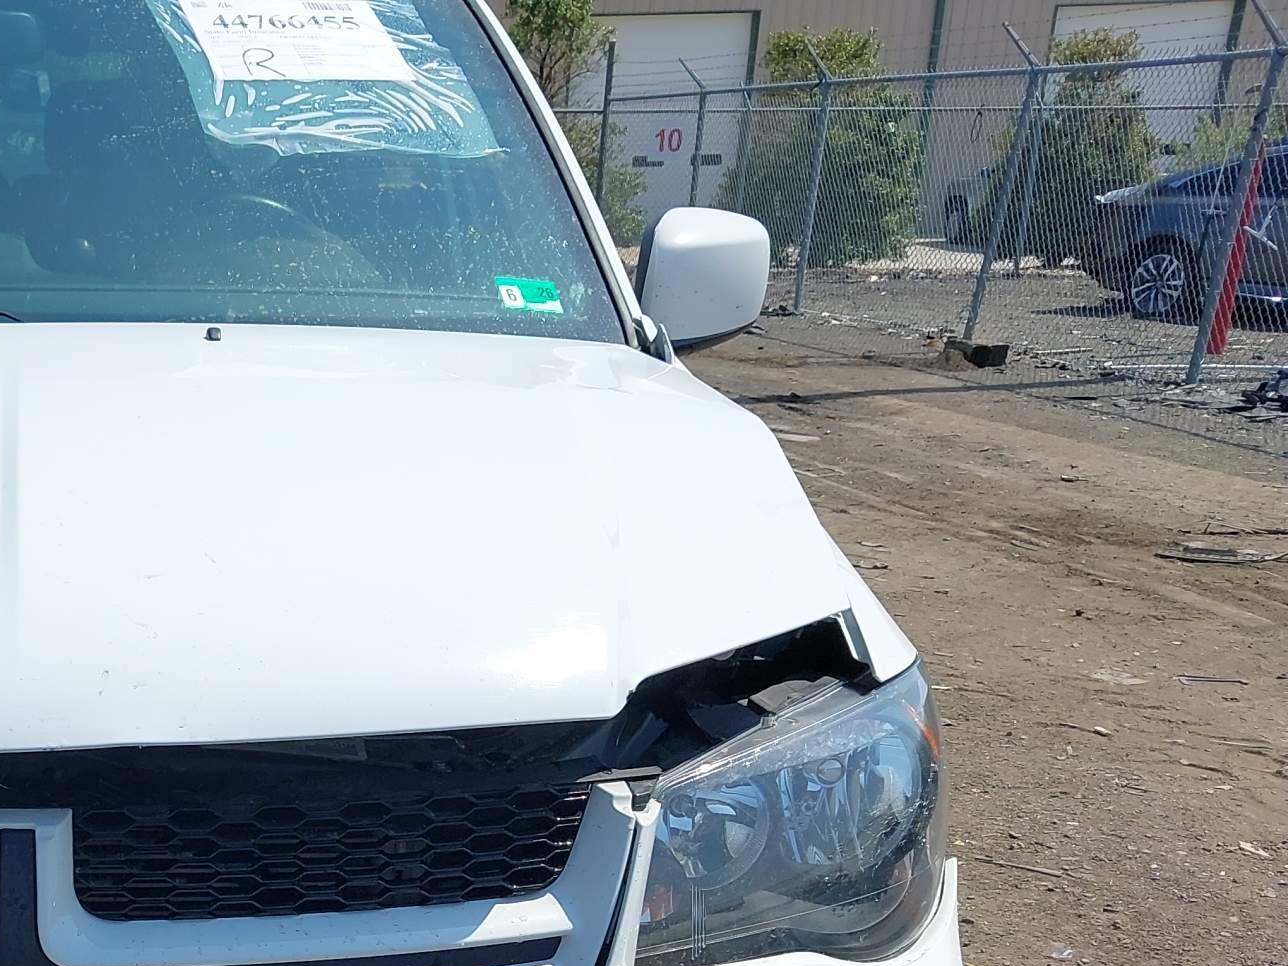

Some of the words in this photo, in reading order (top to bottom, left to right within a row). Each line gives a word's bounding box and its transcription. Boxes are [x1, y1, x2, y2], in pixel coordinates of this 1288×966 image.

[212, 14, 360, 29] 44766455
[242, 47, 287, 77] R
[656, 128, 682, 152] 10
[506, 288, 517, 301] 6
